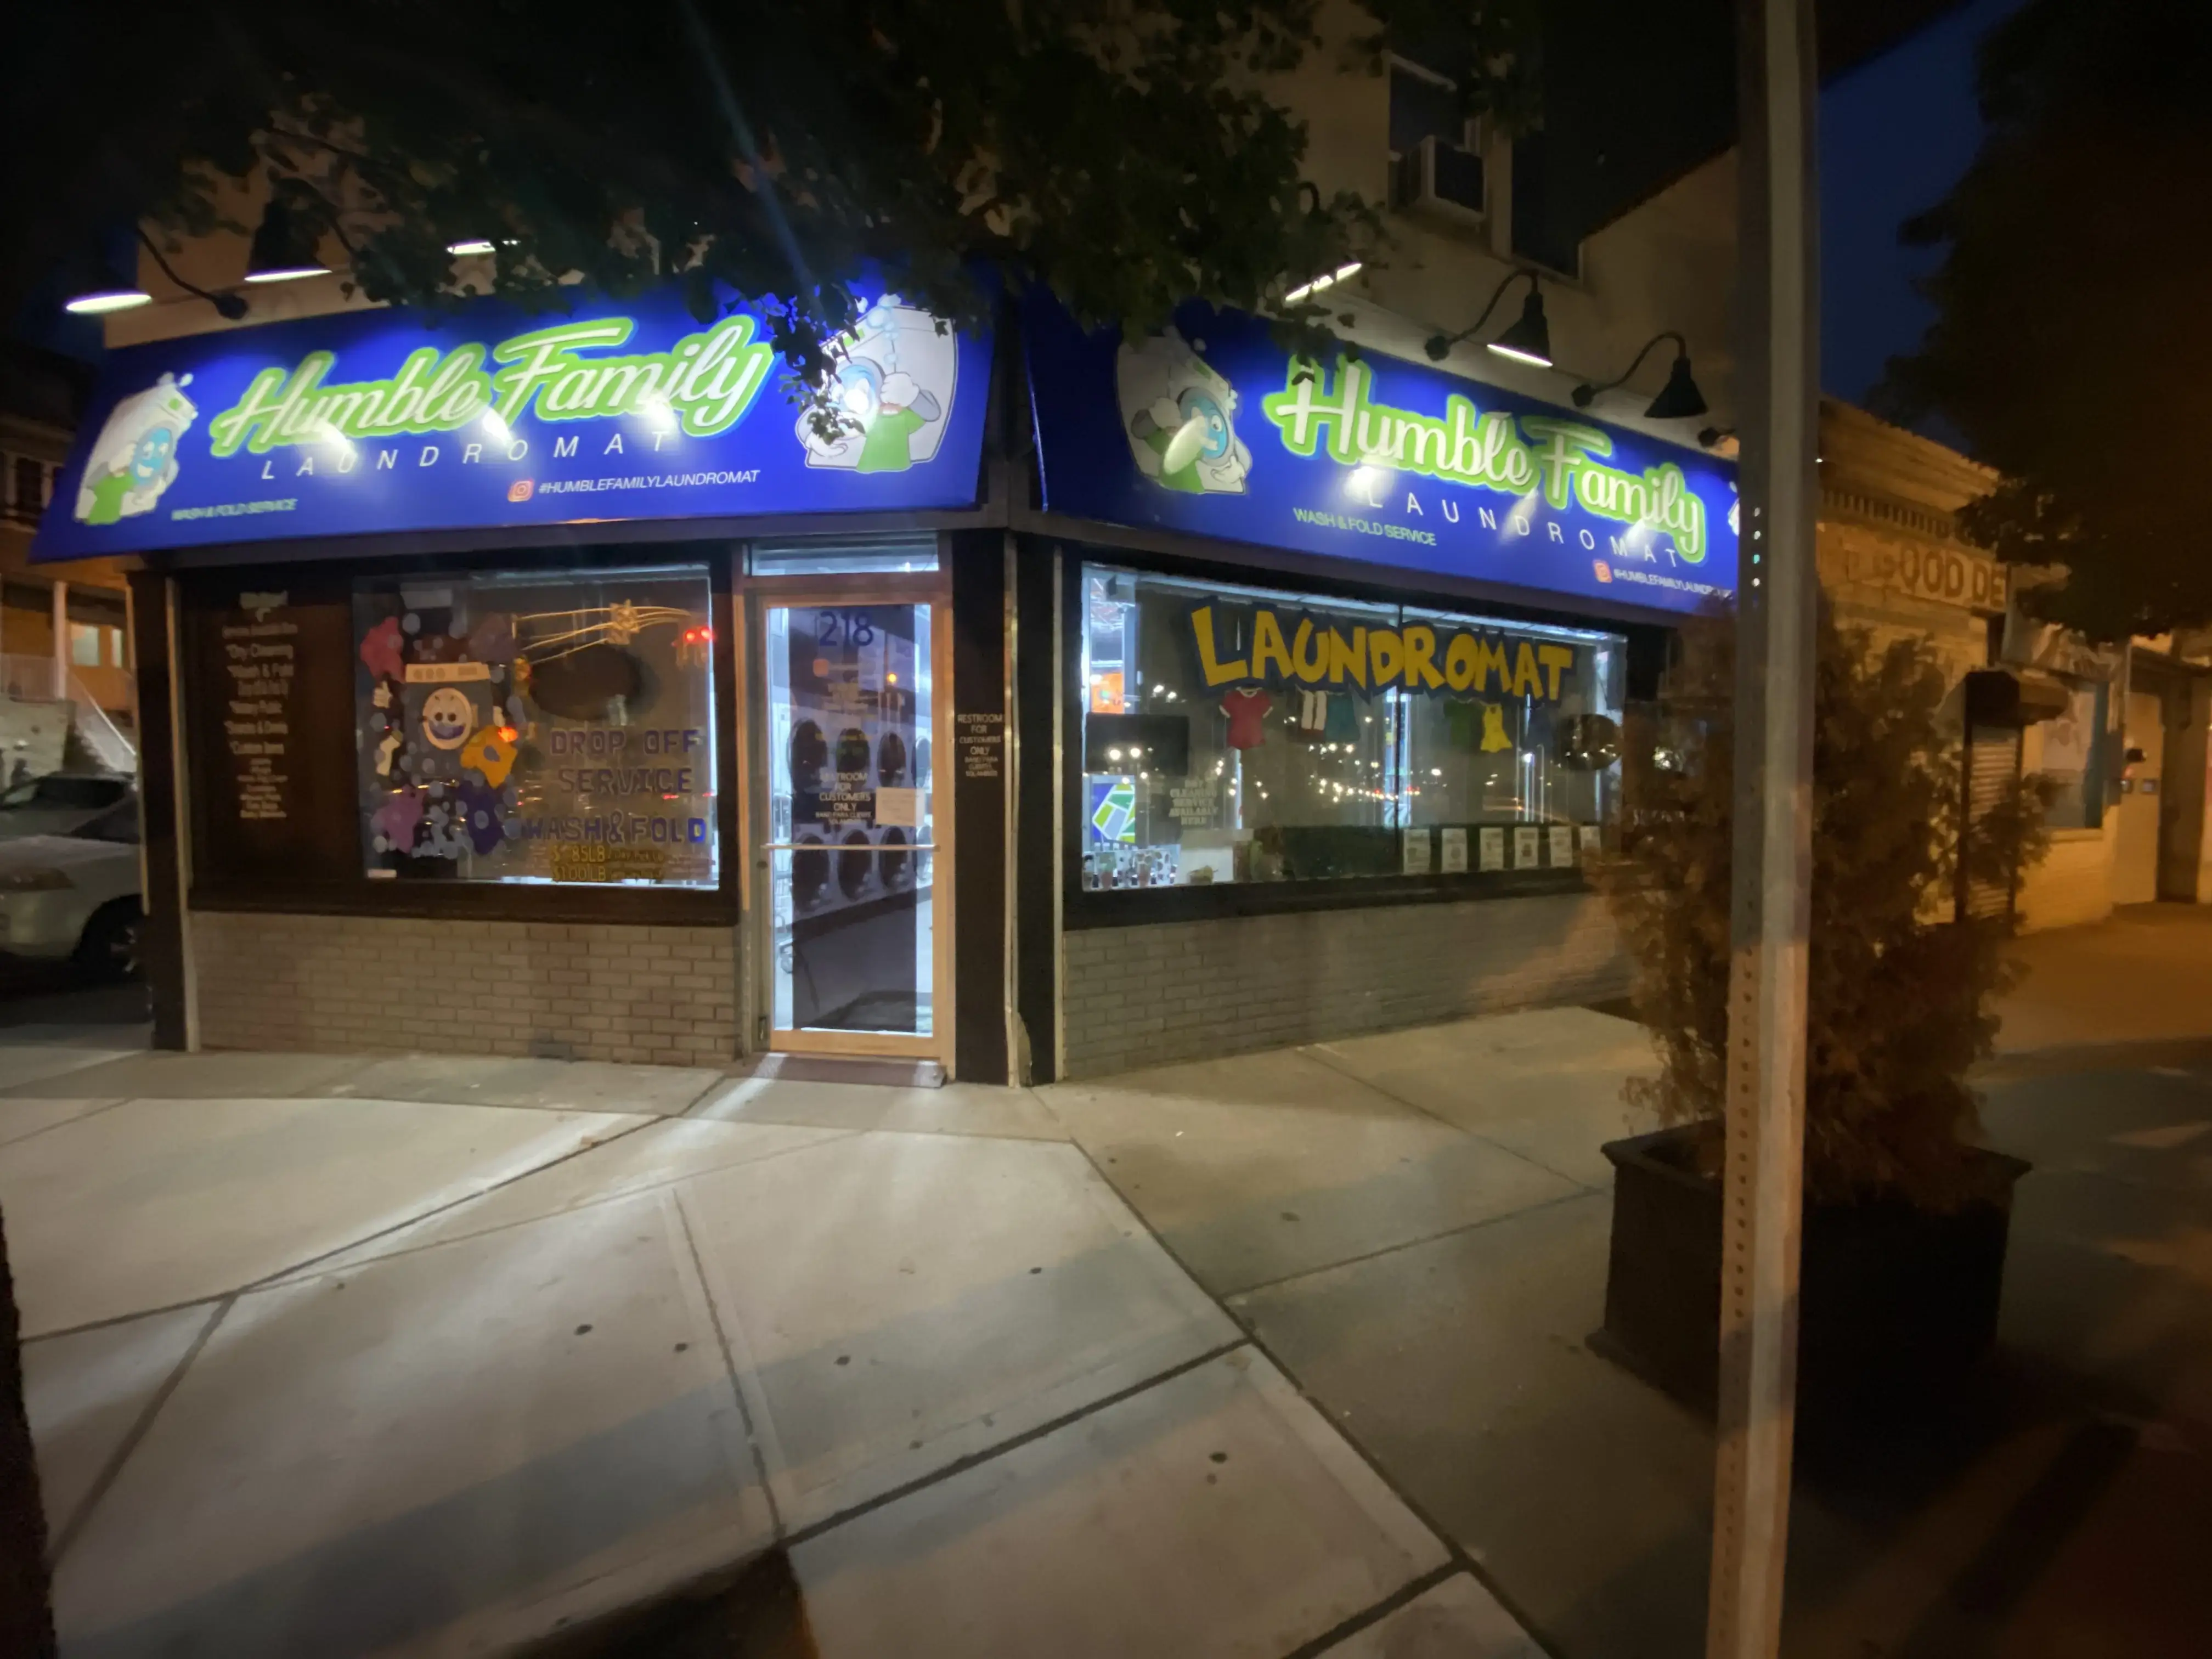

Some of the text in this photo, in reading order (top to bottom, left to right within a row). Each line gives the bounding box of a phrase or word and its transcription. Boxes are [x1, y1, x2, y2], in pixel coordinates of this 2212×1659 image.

[214, 318, 769, 453] Humble Family
[262, 431, 669, 479] LAUNDROMAT
[1268, 358, 1703, 560] Humble Family
[538, 470, 760, 493] #HUMBLEFAMILYLAUNDROMAT
[1293, 507, 1437, 546] WASH & FOLD SERVICE
[1368, 488, 1677, 567] LAUNDROMAT
[819, 611, 873, 646] 218
[1191, 606, 1573, 701] LAUNDROMAT
[958, 714, 1002, 723] RESTROOM
[971, 725, 988, 733] FOR
[551, 730, 700, 755] DROP OFF
[970, 746, 990, 755] ONLY
[557, 768, 693, 795] SERVICE
[819, 792, 871, 802] CUSTOMERS
[833, 803, 857, 811] ONLY
